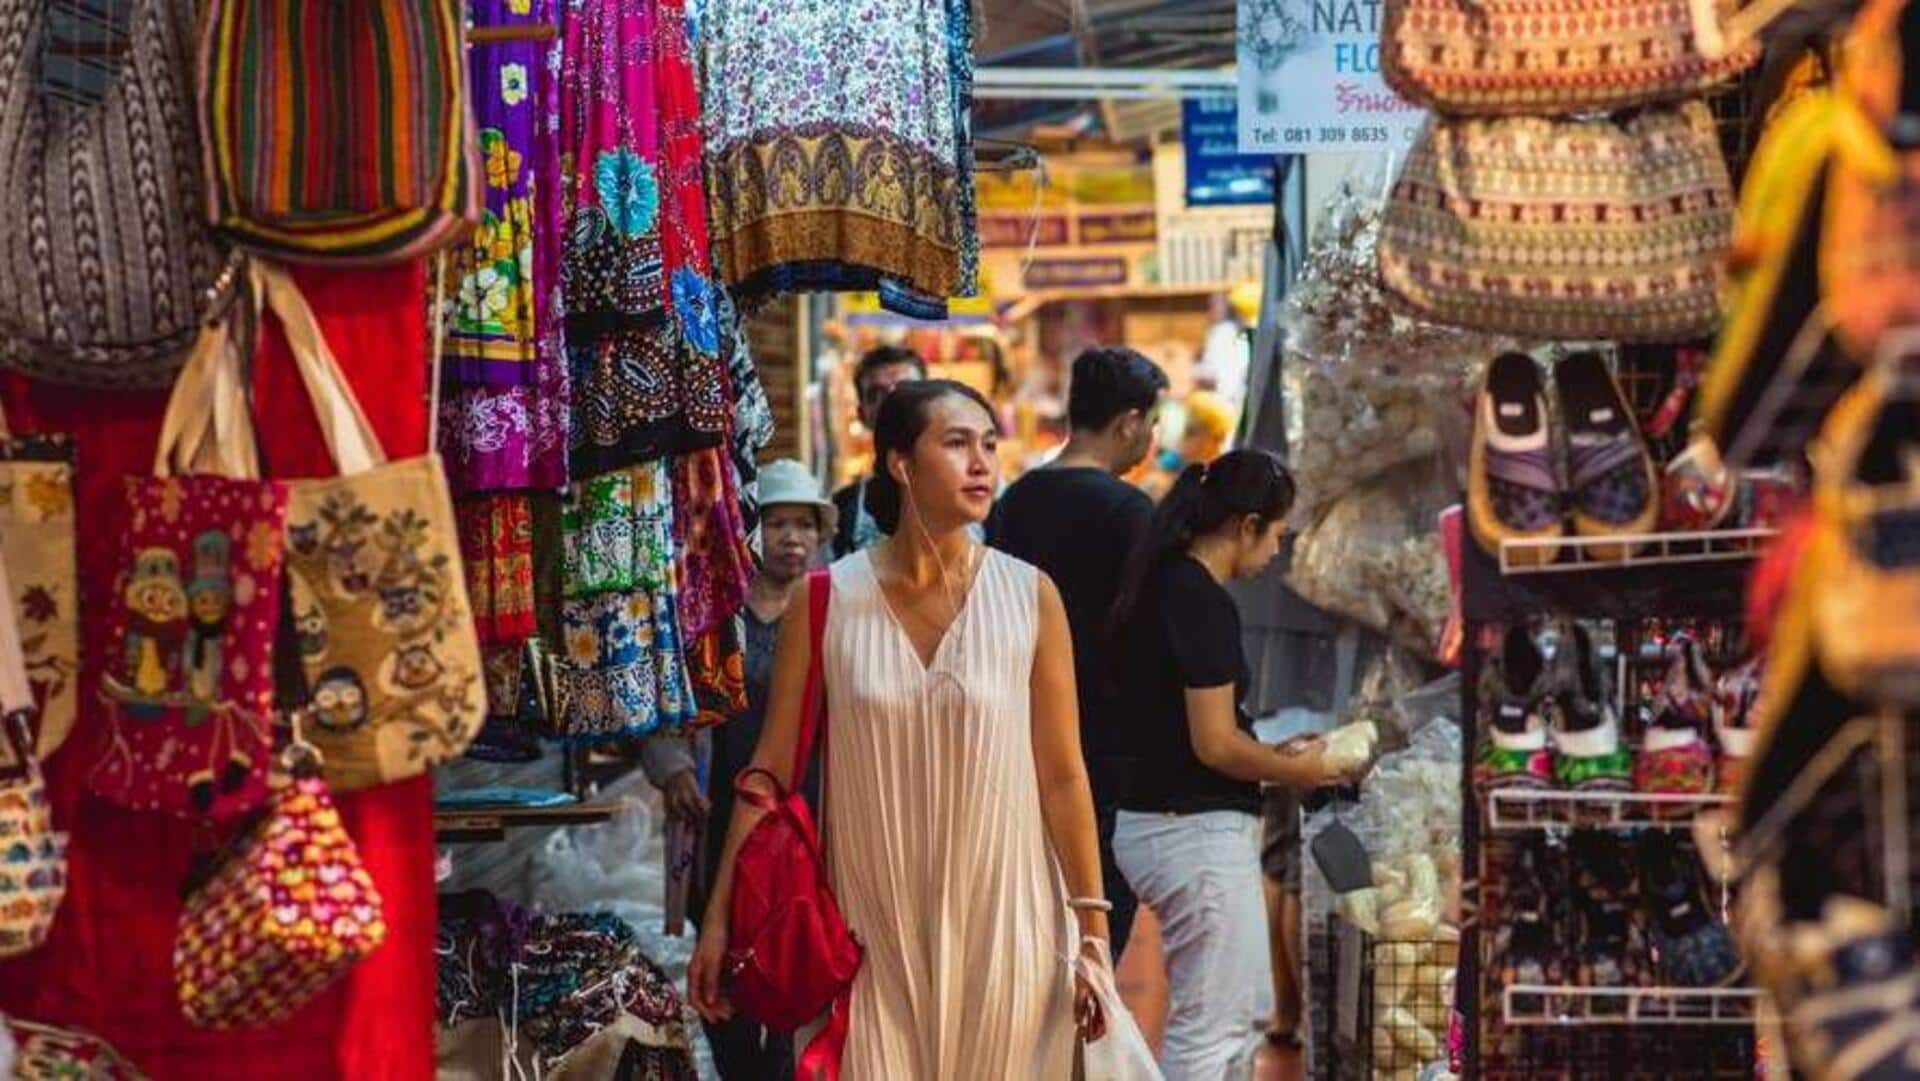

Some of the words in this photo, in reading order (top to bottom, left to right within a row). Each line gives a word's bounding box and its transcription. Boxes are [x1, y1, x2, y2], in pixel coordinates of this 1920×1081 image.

[1253, 127, 1278, 143] Tel:
[1284, 127, 1312, 143] 081
[1319, 127, 1346, 142] 309
[1351, 127, 1389, 142] 8635
